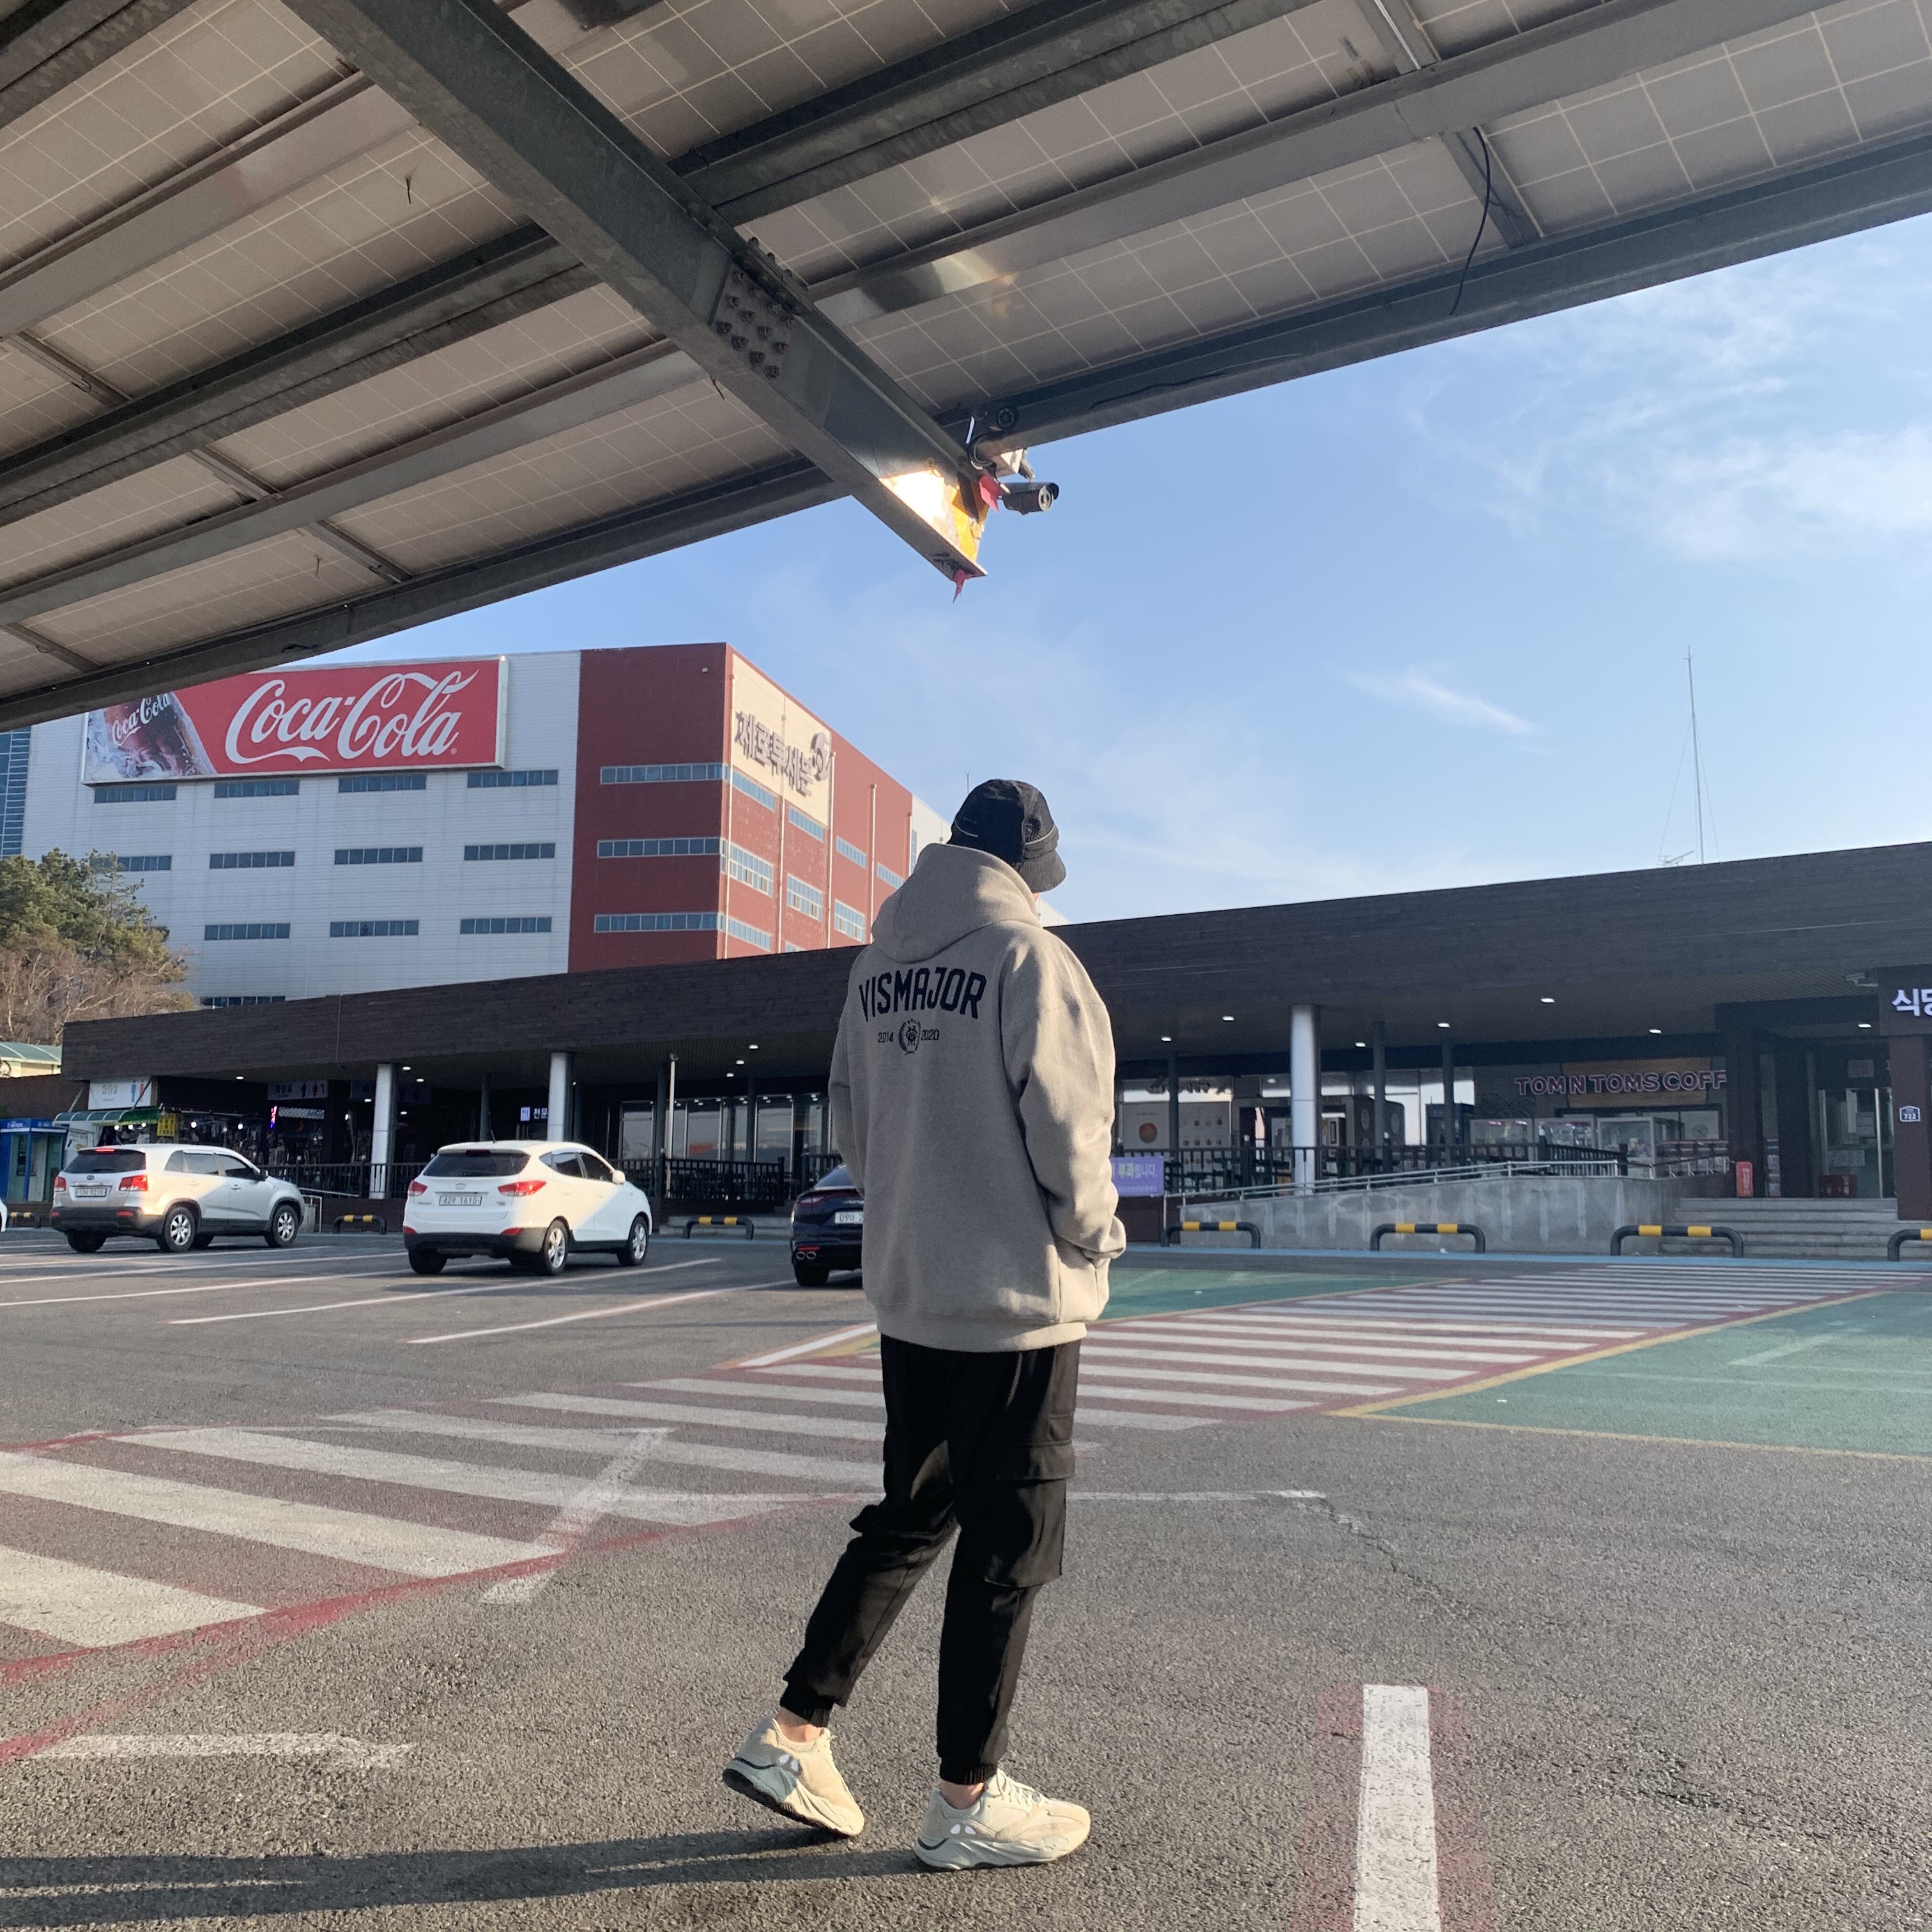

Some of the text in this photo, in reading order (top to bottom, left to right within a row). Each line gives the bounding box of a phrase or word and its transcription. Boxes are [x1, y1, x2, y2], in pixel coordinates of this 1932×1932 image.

[112, 693, 171, 746] Coca-Cola
[226, 670, 479, 763] Coca-Cola
[859, 966, 987, 1023] VISMAJOR
[878, 1032, 894, 1043] 2014
[920, 1029, 940, 1041] 2020
[1514, 1076, 1566, 1095] TOM
[1569, 1075, 1586, 1094] N
[1588, 1072, 1660, 1093] TOMS
